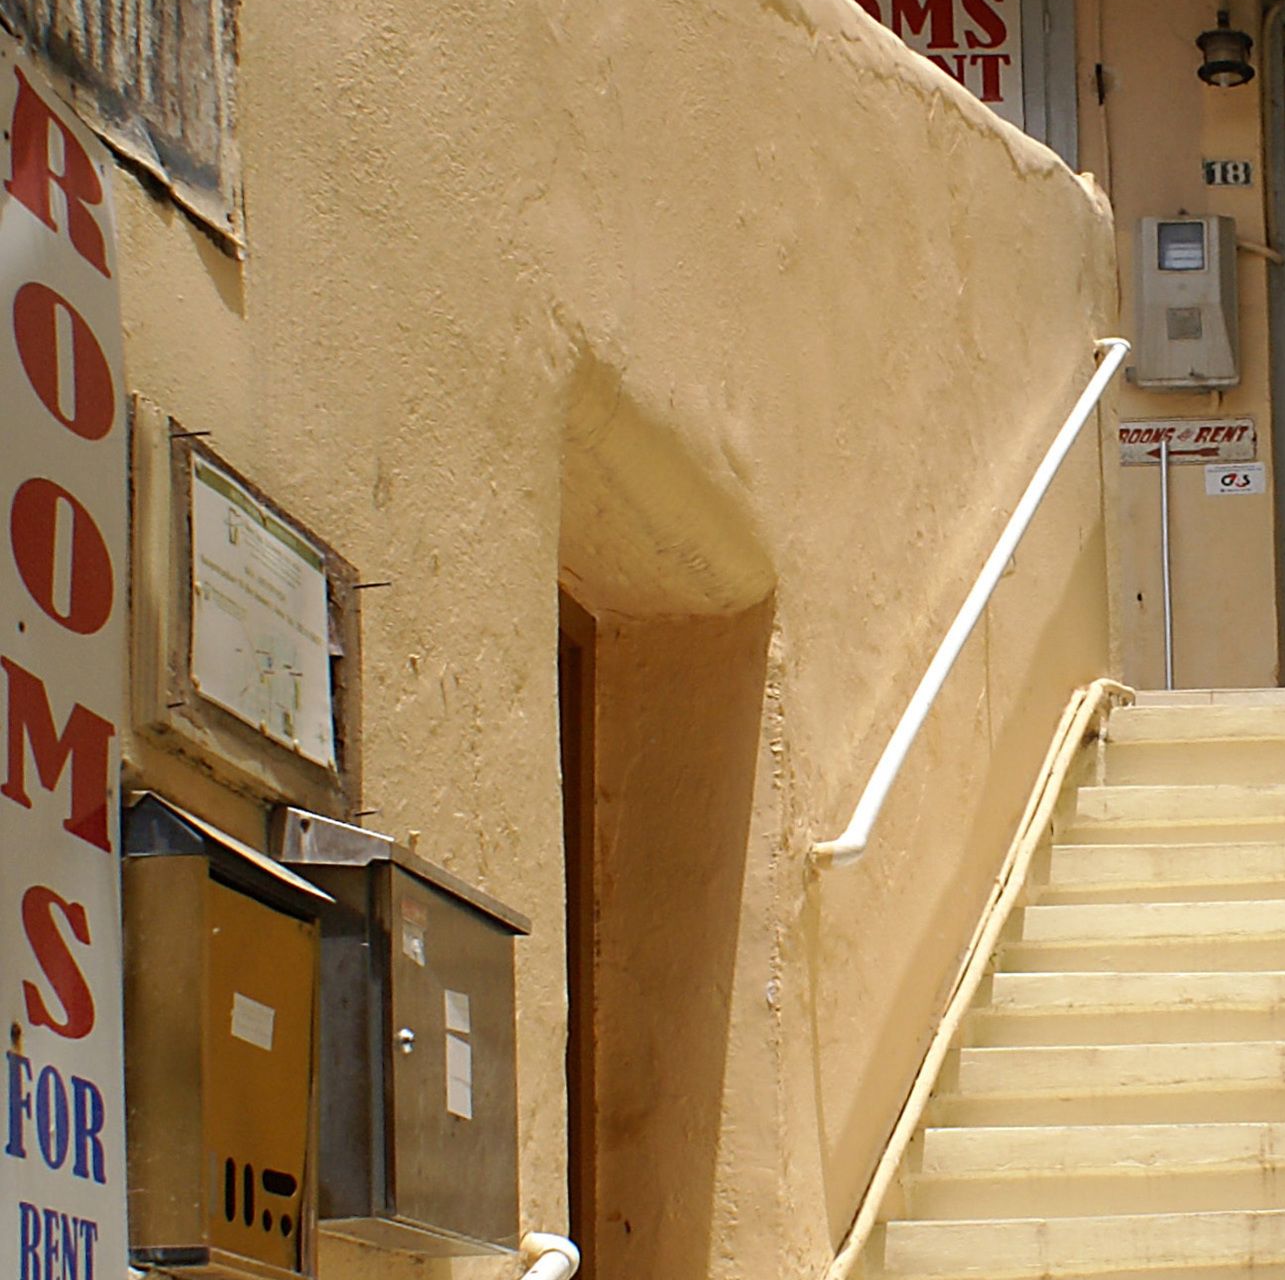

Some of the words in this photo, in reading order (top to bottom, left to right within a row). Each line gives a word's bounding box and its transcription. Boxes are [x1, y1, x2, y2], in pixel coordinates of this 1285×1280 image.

[1211, 161, 1247, 185] 18
[1194, 426, 1250, 444] RENT
[1, 64, 116, 1040] ROOMS
[5, 1050, 107, 1185] FOR
